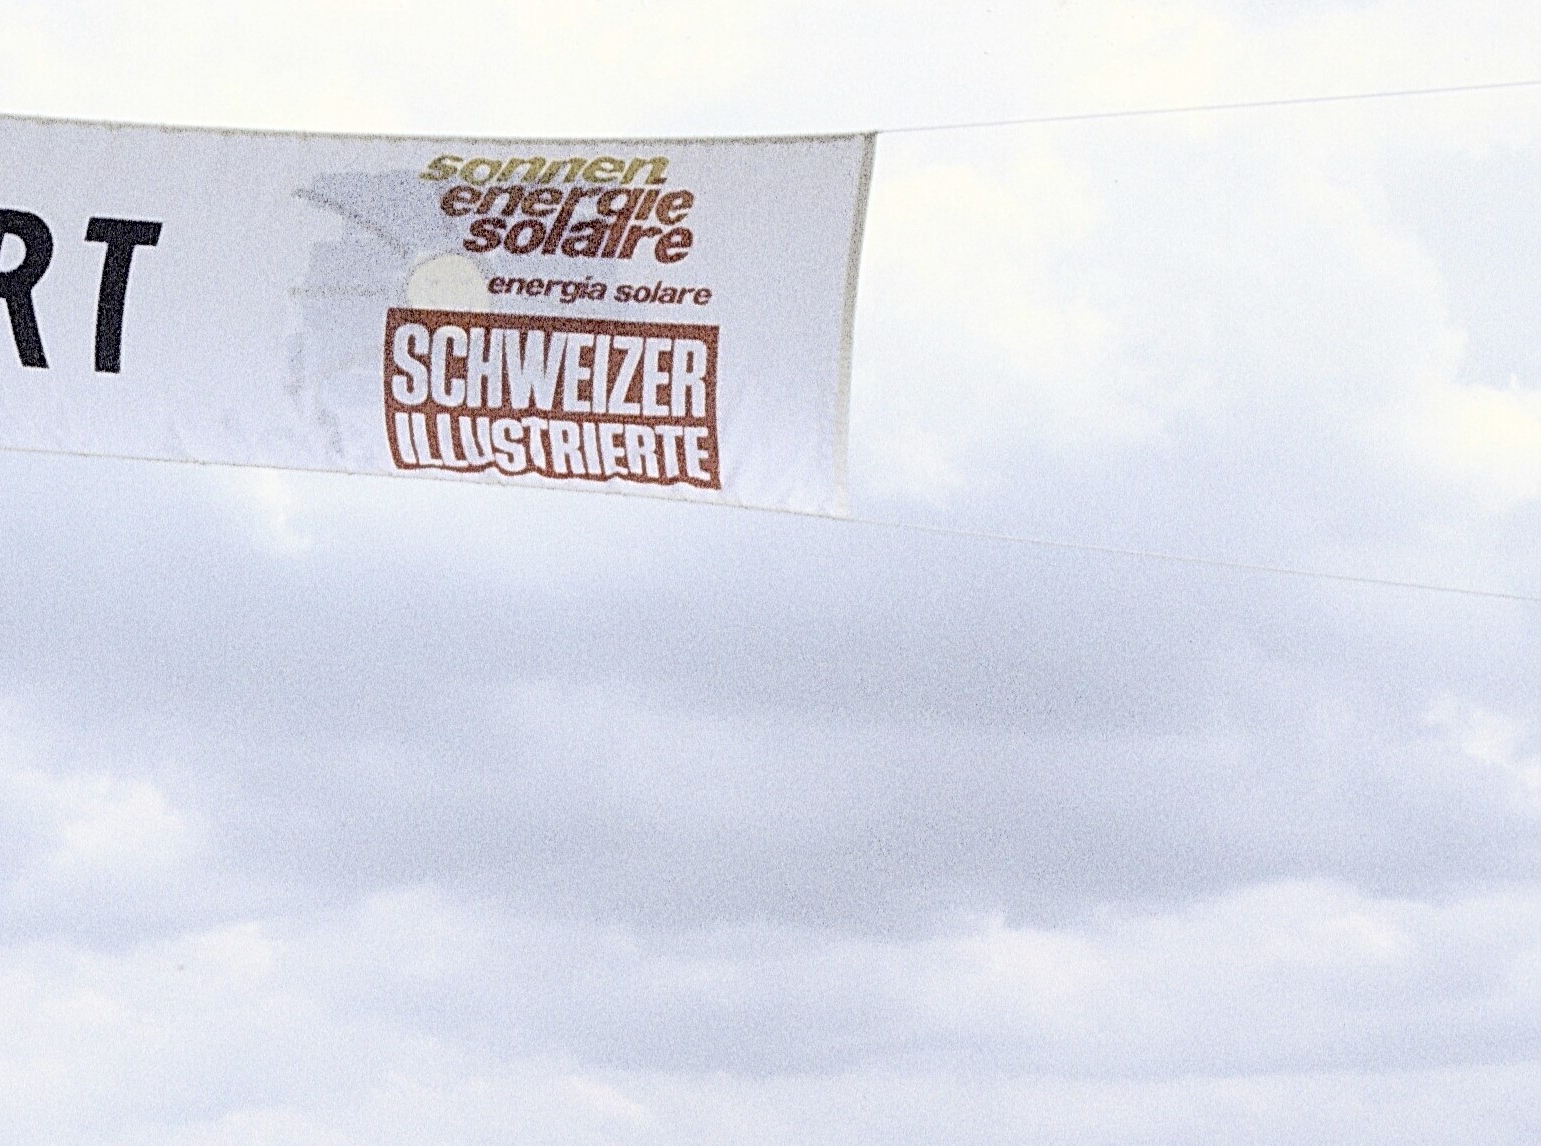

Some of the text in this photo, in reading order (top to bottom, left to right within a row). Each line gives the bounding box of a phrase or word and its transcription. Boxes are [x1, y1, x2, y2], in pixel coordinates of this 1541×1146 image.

[420, 154, 669, 186] sonnen
[440, 184, 694, 226] energie
[462, 212, 693, 264] solaire
[614, 281, 712, 305] solare
[391, 322, 708, 418] SCHWEIZER
[394, 410, 710, 481] ILLUSTRIERTE
